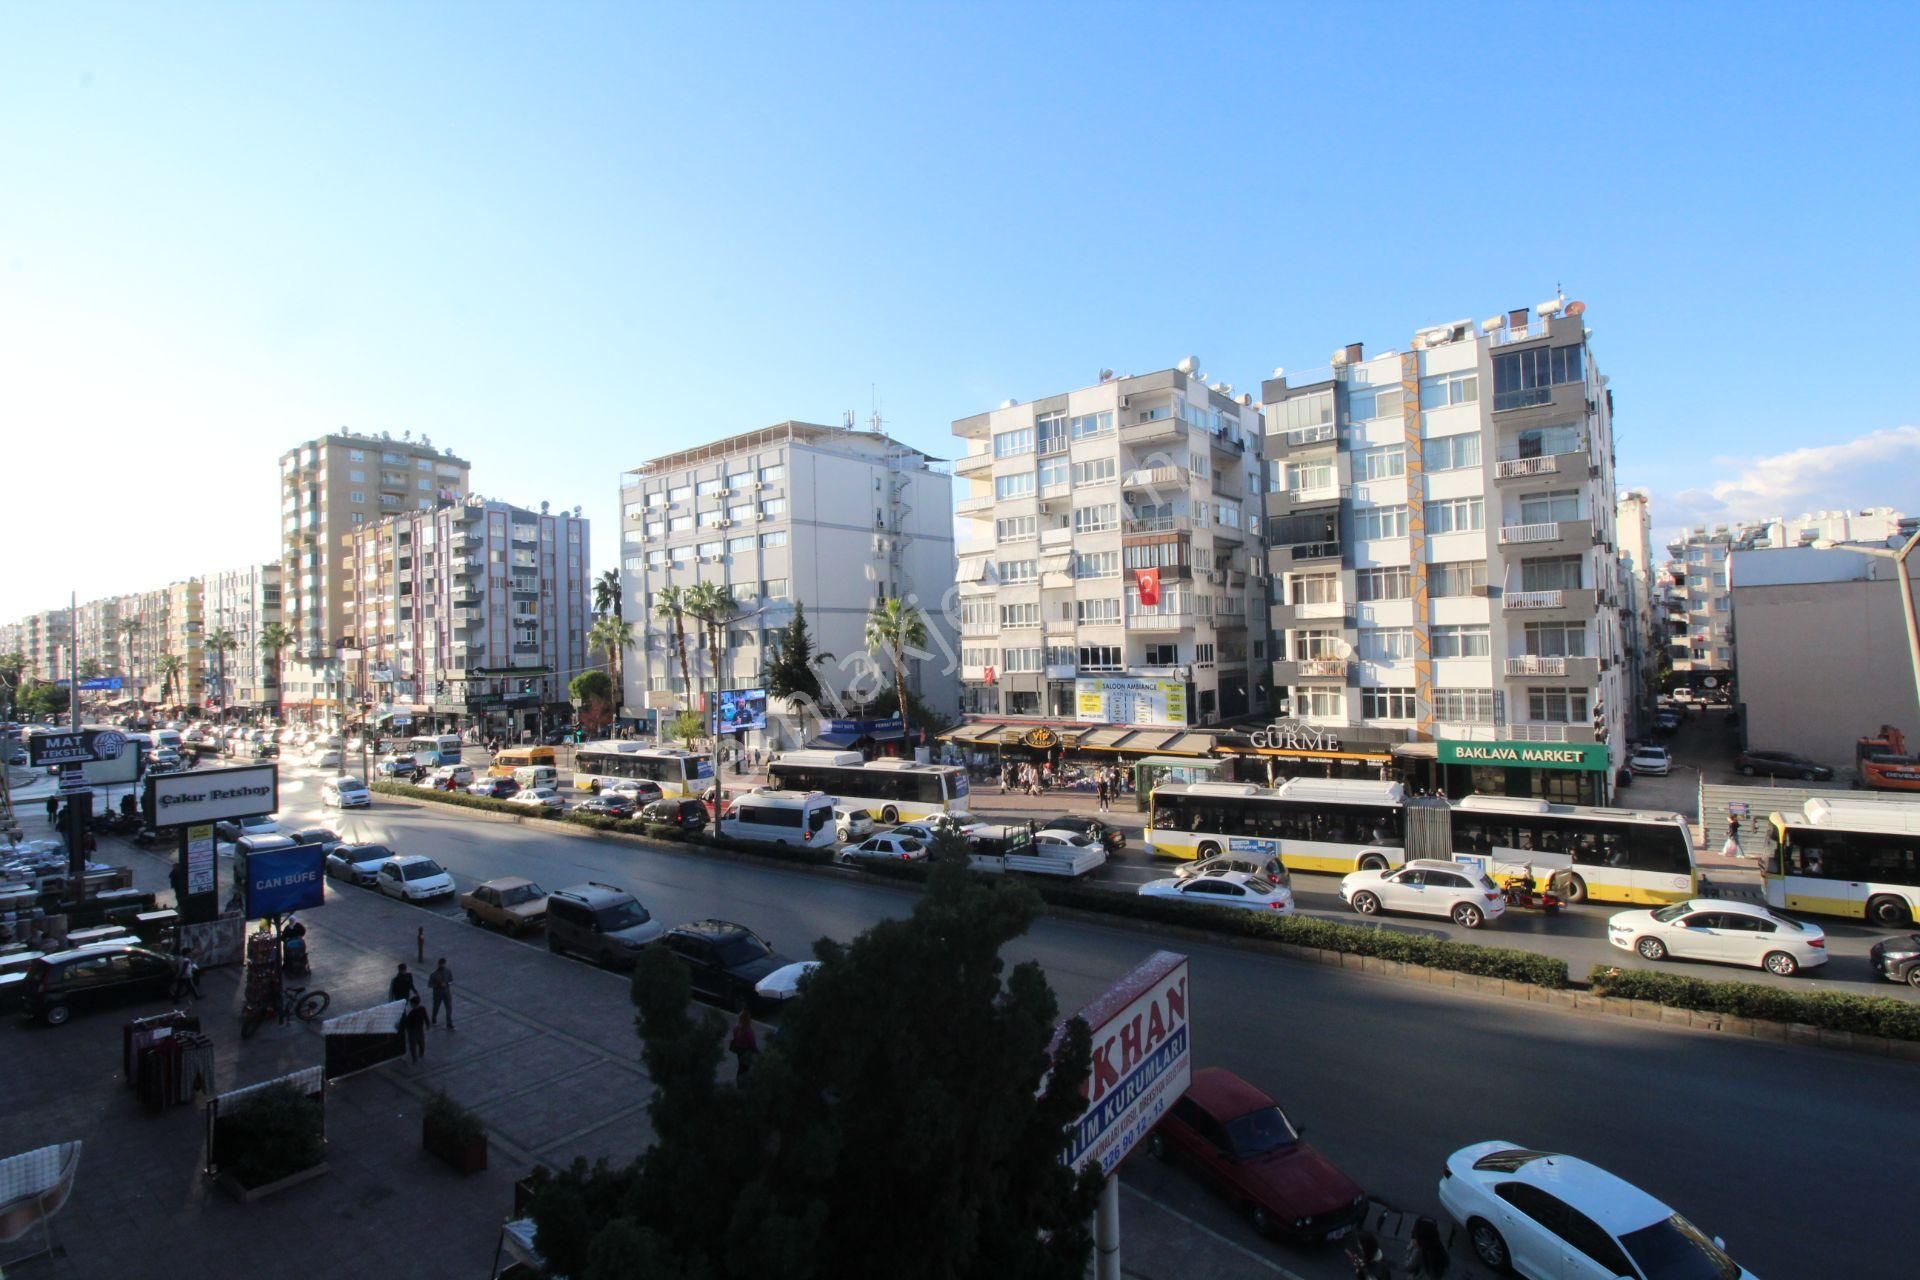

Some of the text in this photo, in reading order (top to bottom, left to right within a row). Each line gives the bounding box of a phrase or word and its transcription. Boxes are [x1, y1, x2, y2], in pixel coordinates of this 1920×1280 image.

[1102, 683, 1126, 691] SALOON
[1127, 683, 1157, 691] AMBIANCE
[46, 736, 83, 749] MAT
[1250, 731, 1339, 751] GURME
[1456, 747, 1584, 763] BAKLAVA MARKET
[160, 786, 270, 807] Çakır Petshop
[256, 870, 316, 890] CAN BÜFE
[1079, 976, 1187, 1102] KHAN
[1104, 1033, 1184, 1125] KURUMLARI
[1122, 1132, 1134, 1151] 90
[1136, 1120, 1147, 1139] 12
[1154, 1099, 1164, 1120] 13
